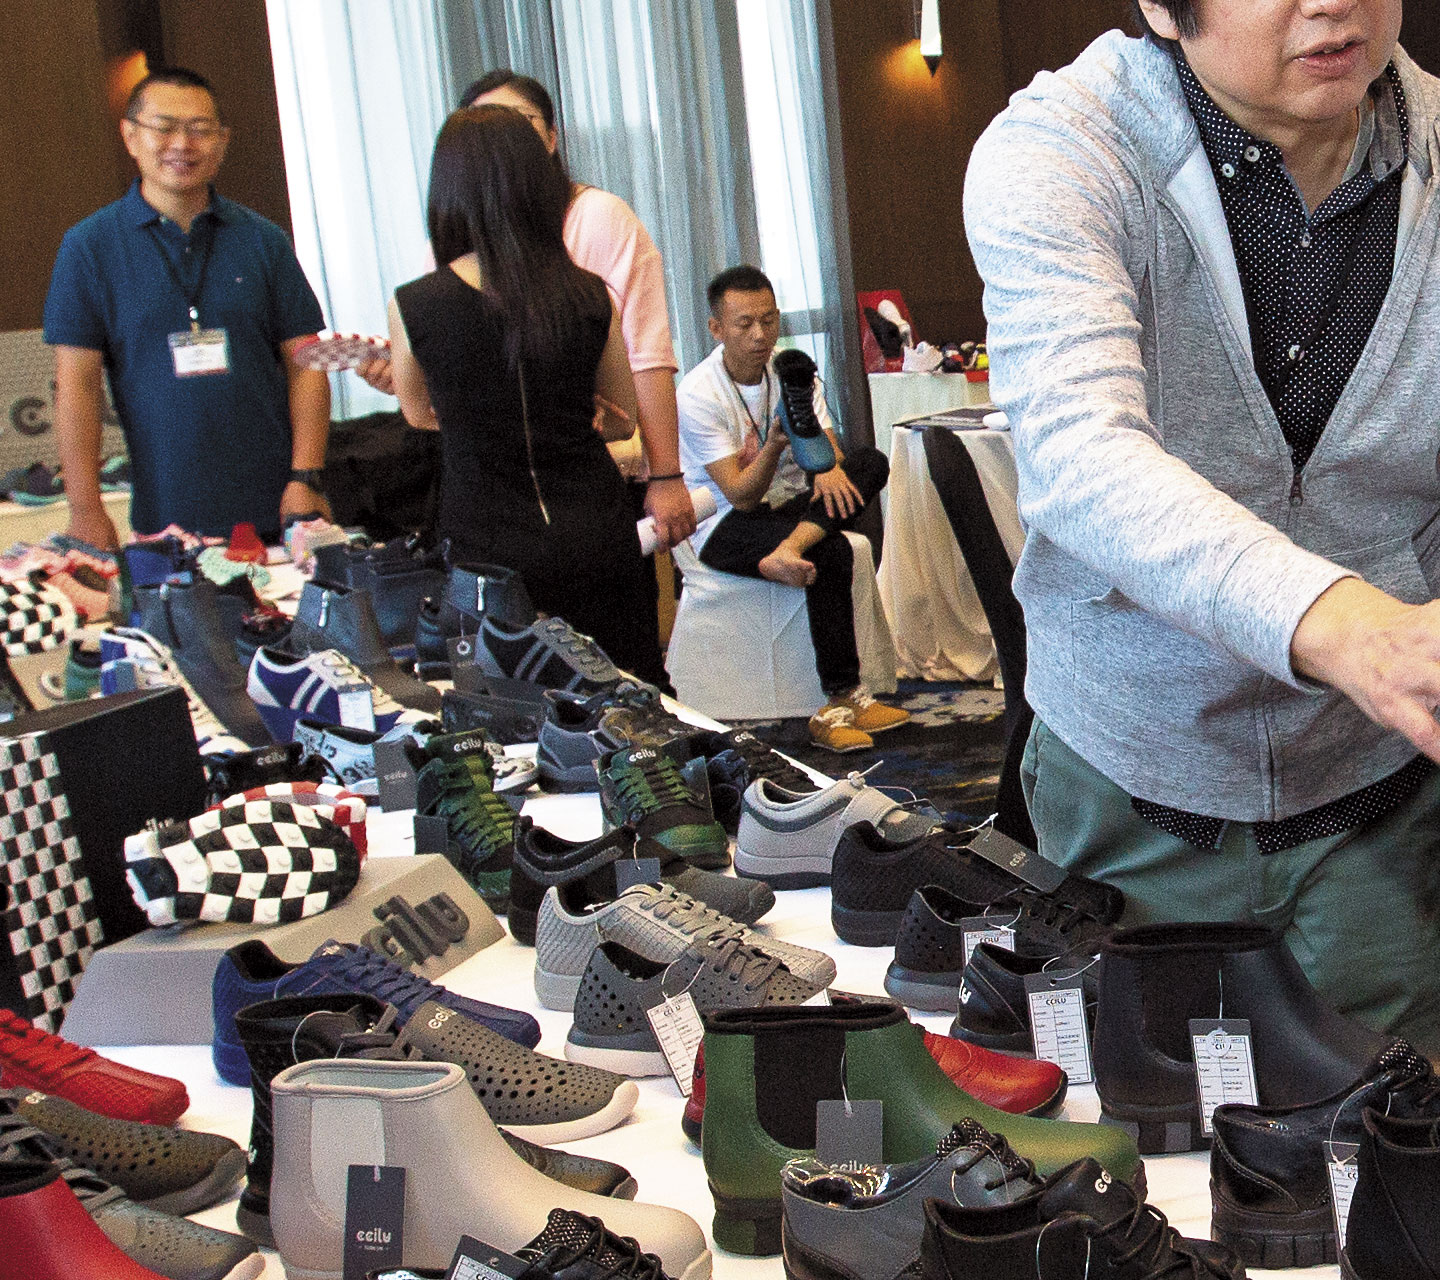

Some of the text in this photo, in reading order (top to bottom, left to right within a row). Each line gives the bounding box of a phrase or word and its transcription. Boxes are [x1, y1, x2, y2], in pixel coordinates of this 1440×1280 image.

[453, 738, 482, 754] ccilu
[628, 747, 657, 764] ccilu
[356, 1227, 392, 1244] ccilu
